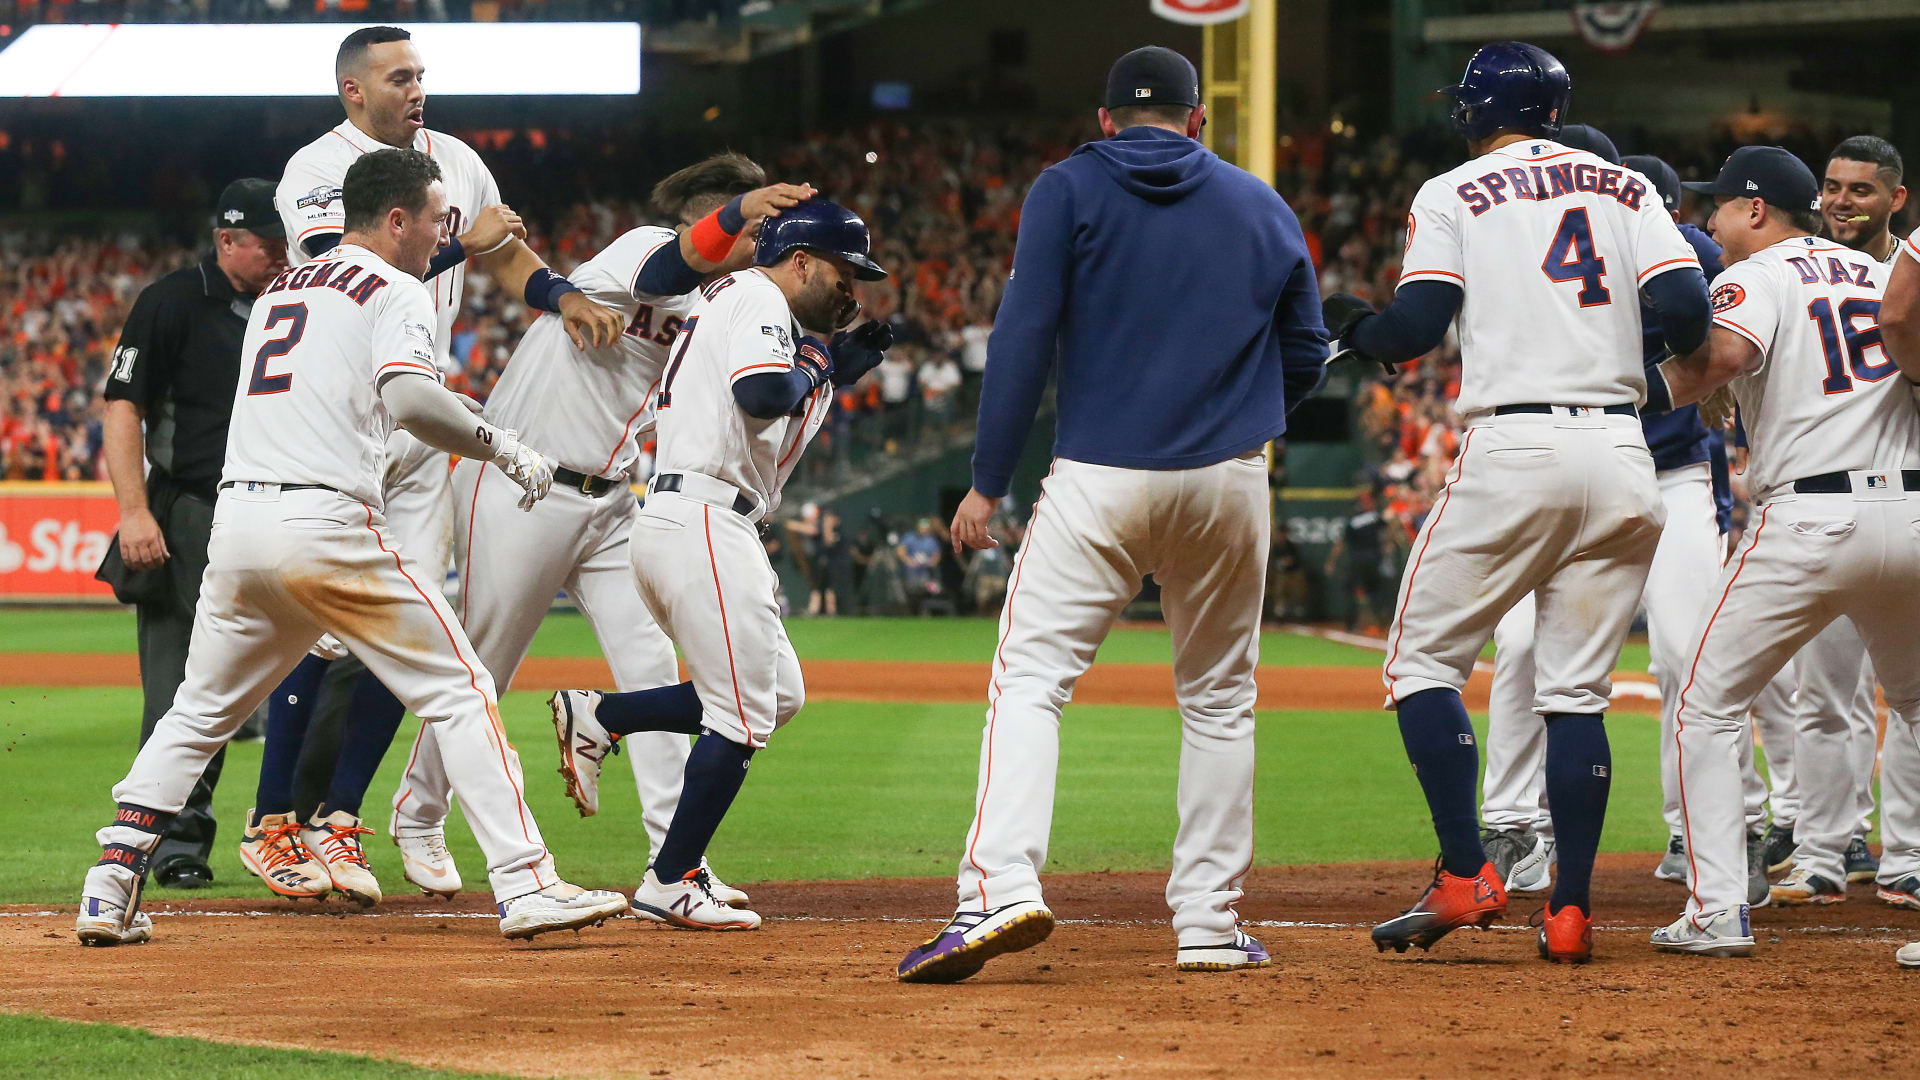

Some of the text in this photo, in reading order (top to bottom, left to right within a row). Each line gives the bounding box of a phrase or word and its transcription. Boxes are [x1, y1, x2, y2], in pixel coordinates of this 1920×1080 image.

[1457, 162, 1647, 217] SPRINGER
[257, 261, 388, 307] EGMAN
[1541, 206, 1612, 308] 4
[248, 301, 308, 395] 2
[1808, 297, 1901, 395] 16
[475, 425, 493, 446] 2
[669, 892, 704, 917] N
